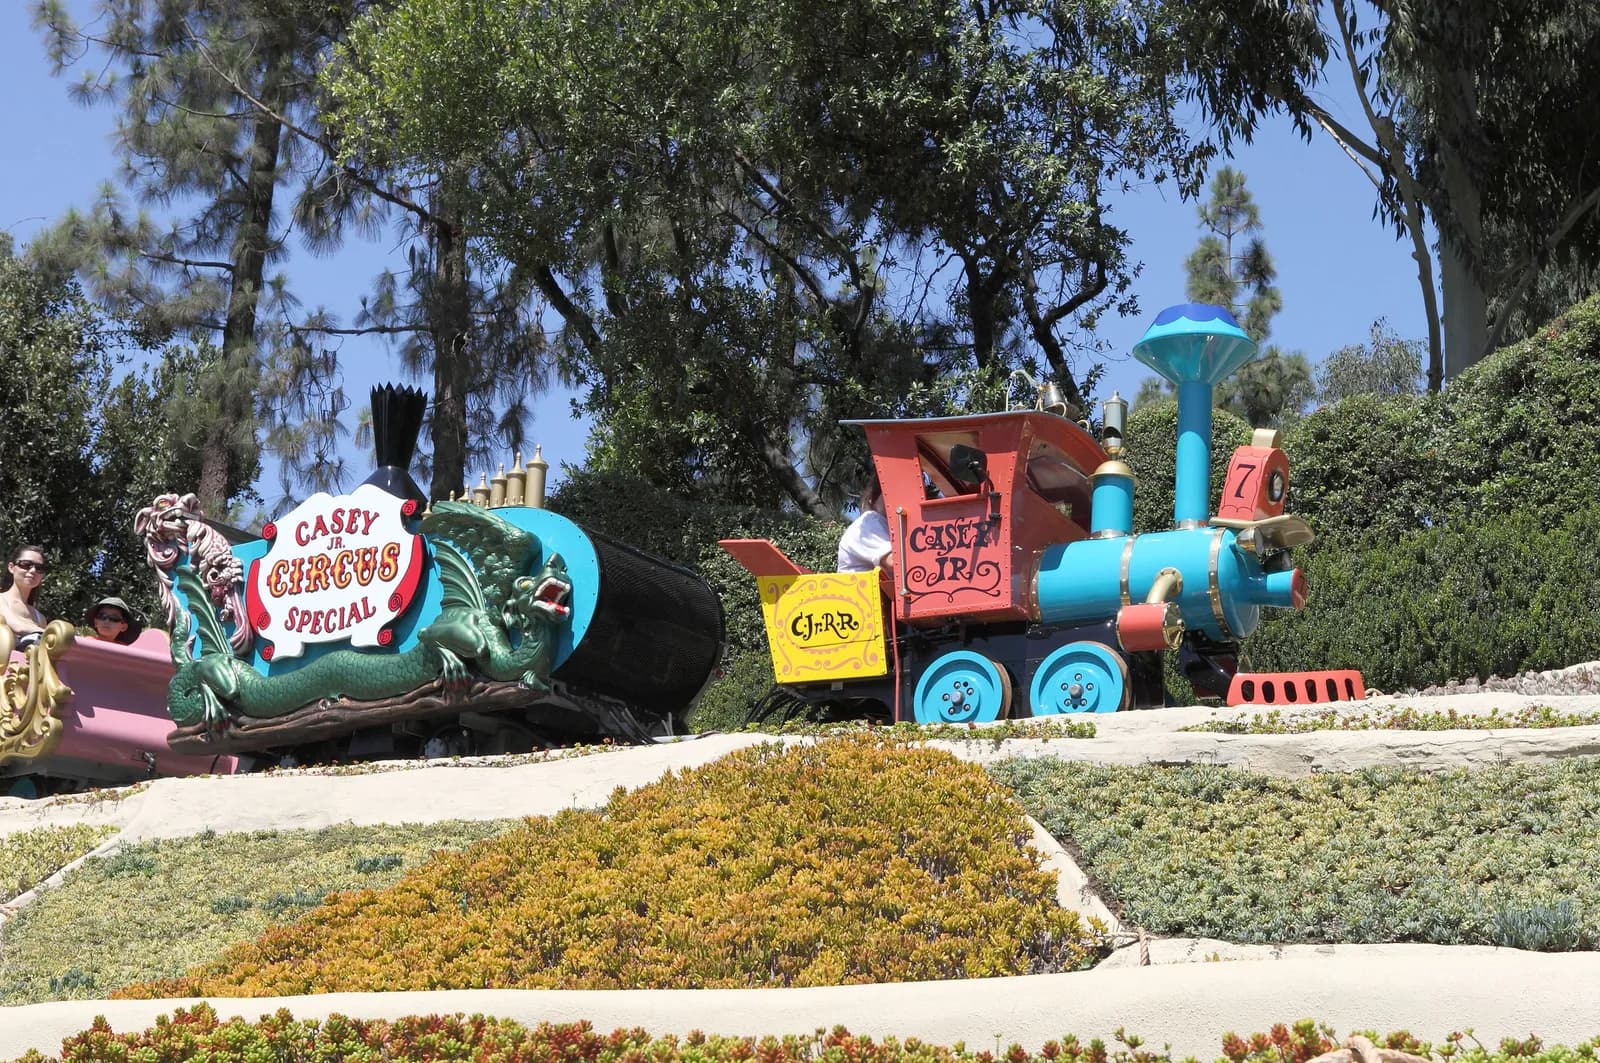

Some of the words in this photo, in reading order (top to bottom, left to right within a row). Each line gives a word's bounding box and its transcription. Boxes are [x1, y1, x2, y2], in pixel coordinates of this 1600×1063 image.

[1234, 463, 1256, 498] 7
[295, 508, 380, 546] CASEY
[327, 536, 346, 550] JR.
[910, 517, 994, 556] CASEY
[267, 542, 400, 598] CIRCUS
[927, 556, 973, 587] JR
[284, 596, 376, 634] SPECIAL
